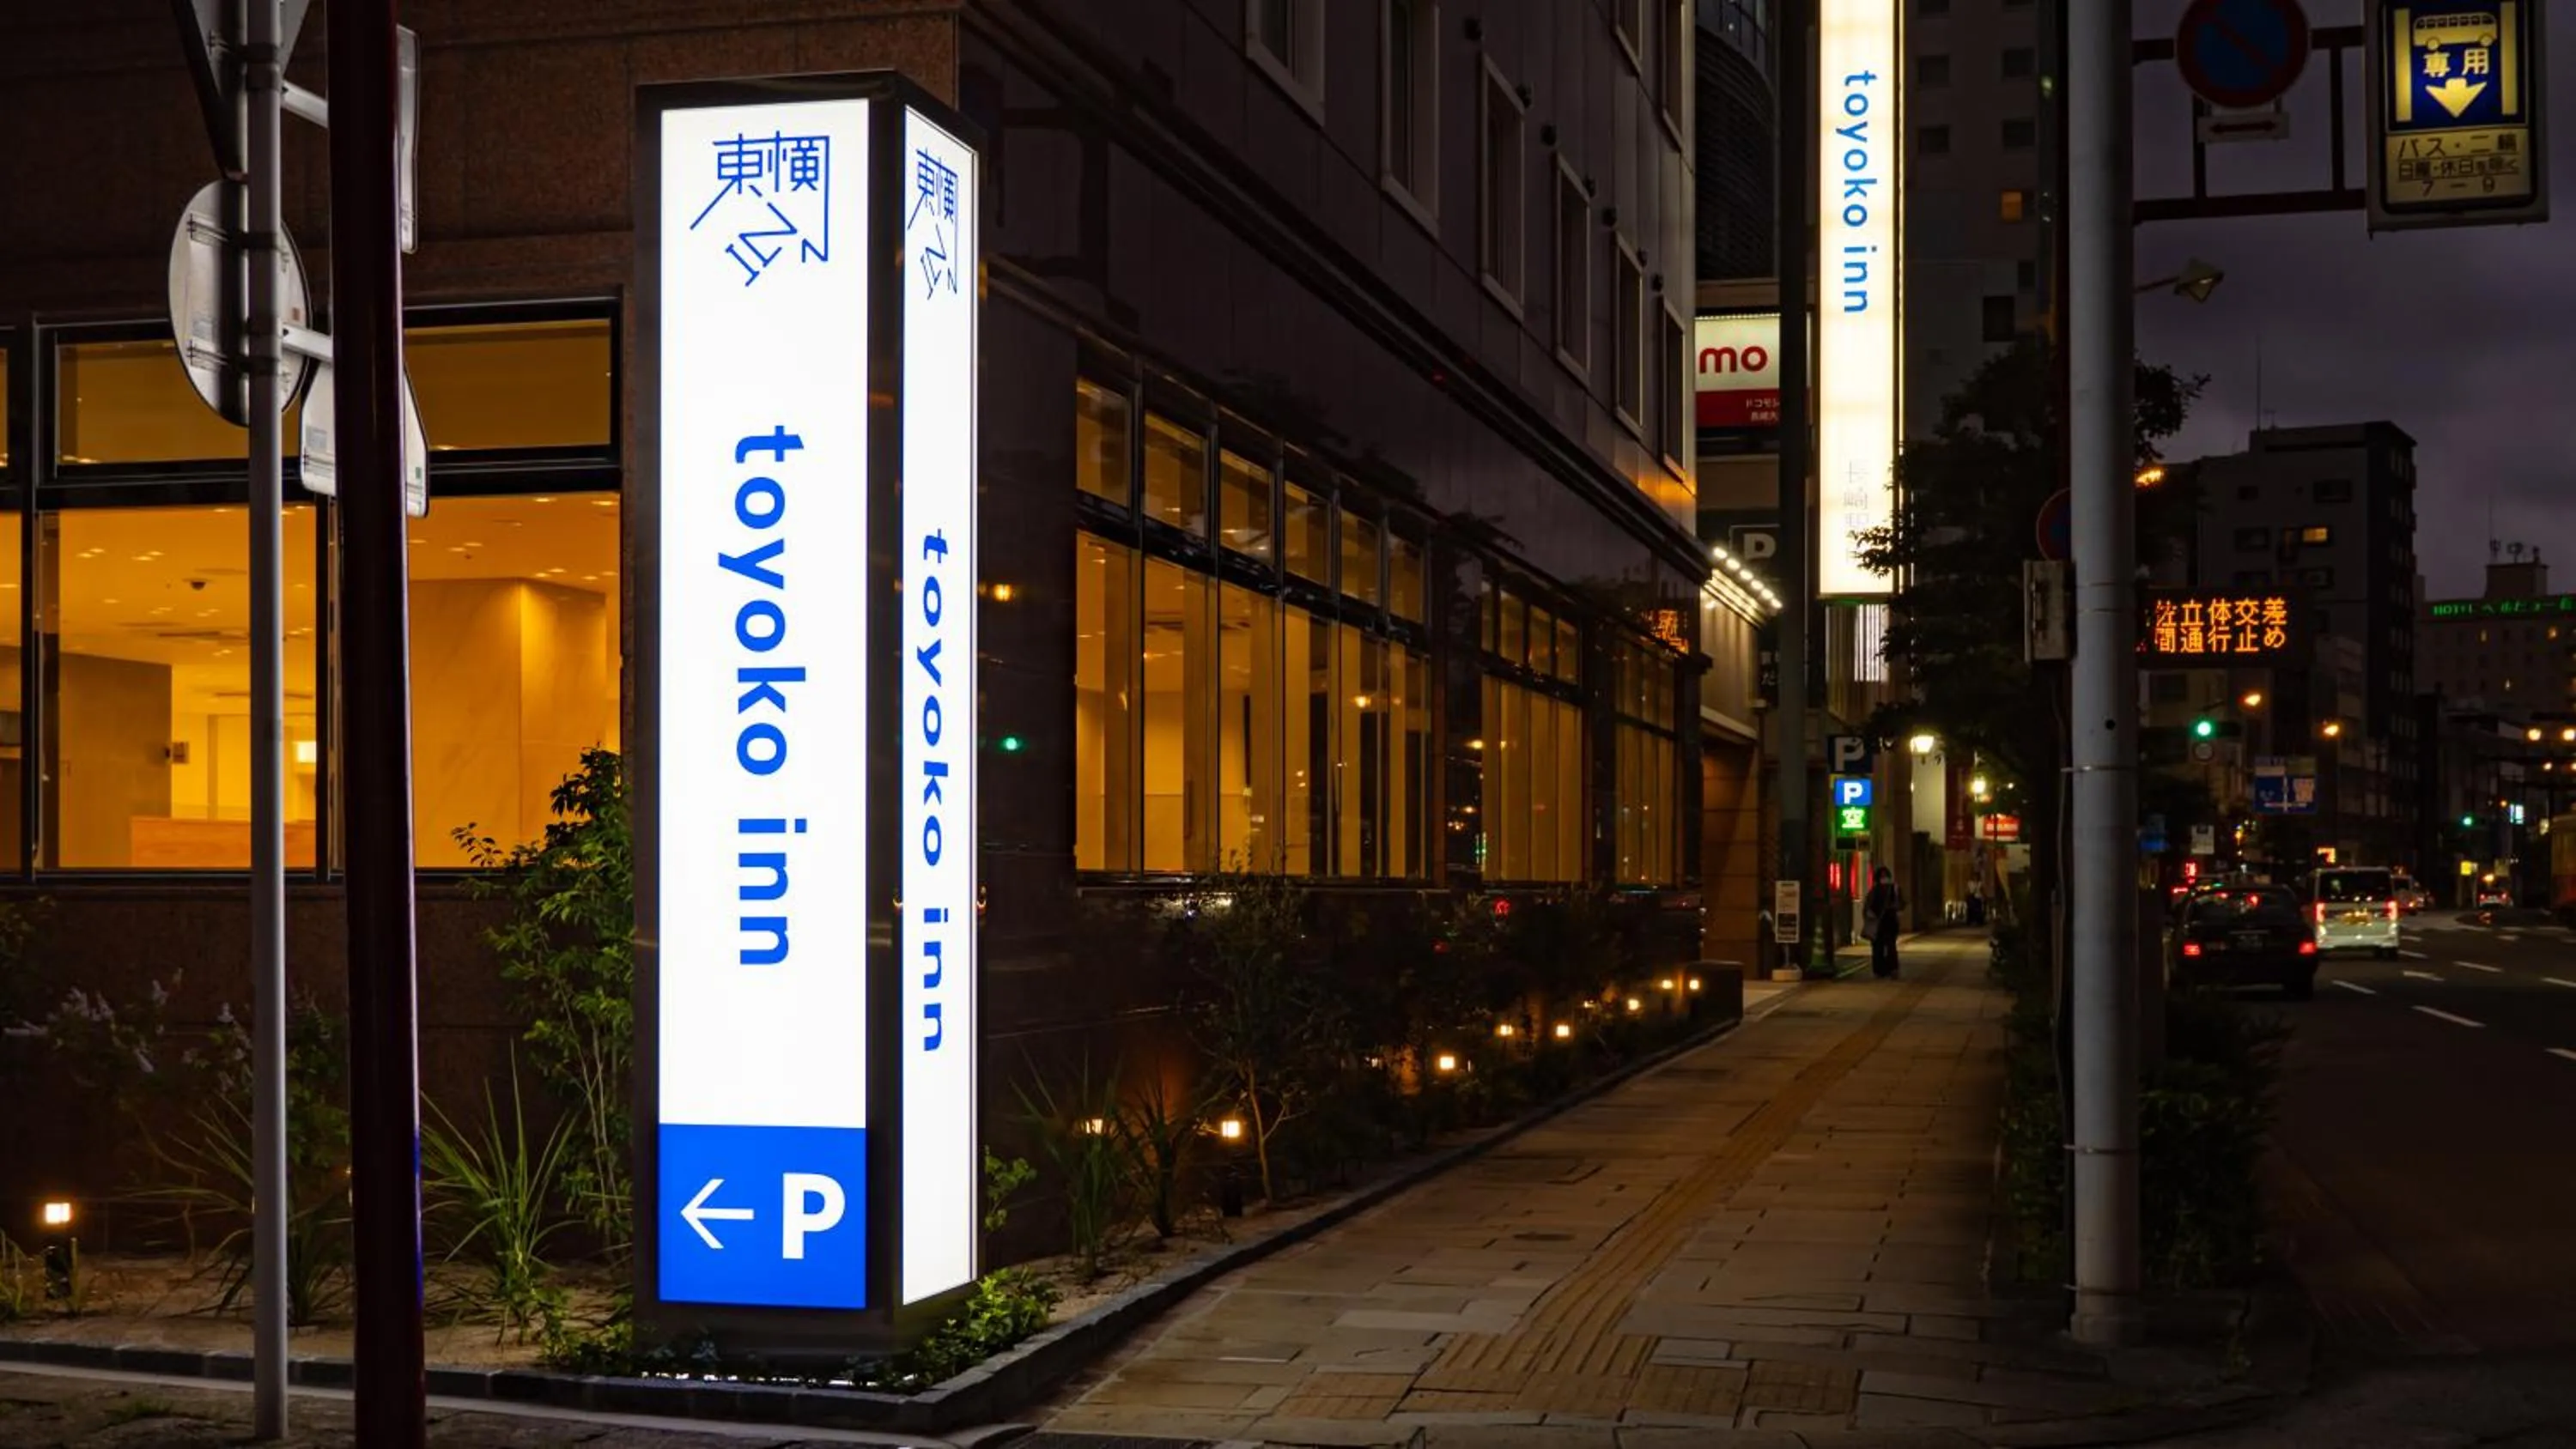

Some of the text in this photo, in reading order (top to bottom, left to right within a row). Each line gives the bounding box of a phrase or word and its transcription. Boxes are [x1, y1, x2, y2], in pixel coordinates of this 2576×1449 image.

[2423, 48, 2489, 77] 専用
[1836, 70, 1878, 313] toyoko inn
[2154, 625, 2287, 653] 間通行止め
[718, 425, 807, 965] toyoko inn
[1835, 737, 1865, 772] P
[917, 529, 948, 1051] toyoko inn
[1843, 782, 1863, 804] P
[782, 1173, 846, 1259] P
